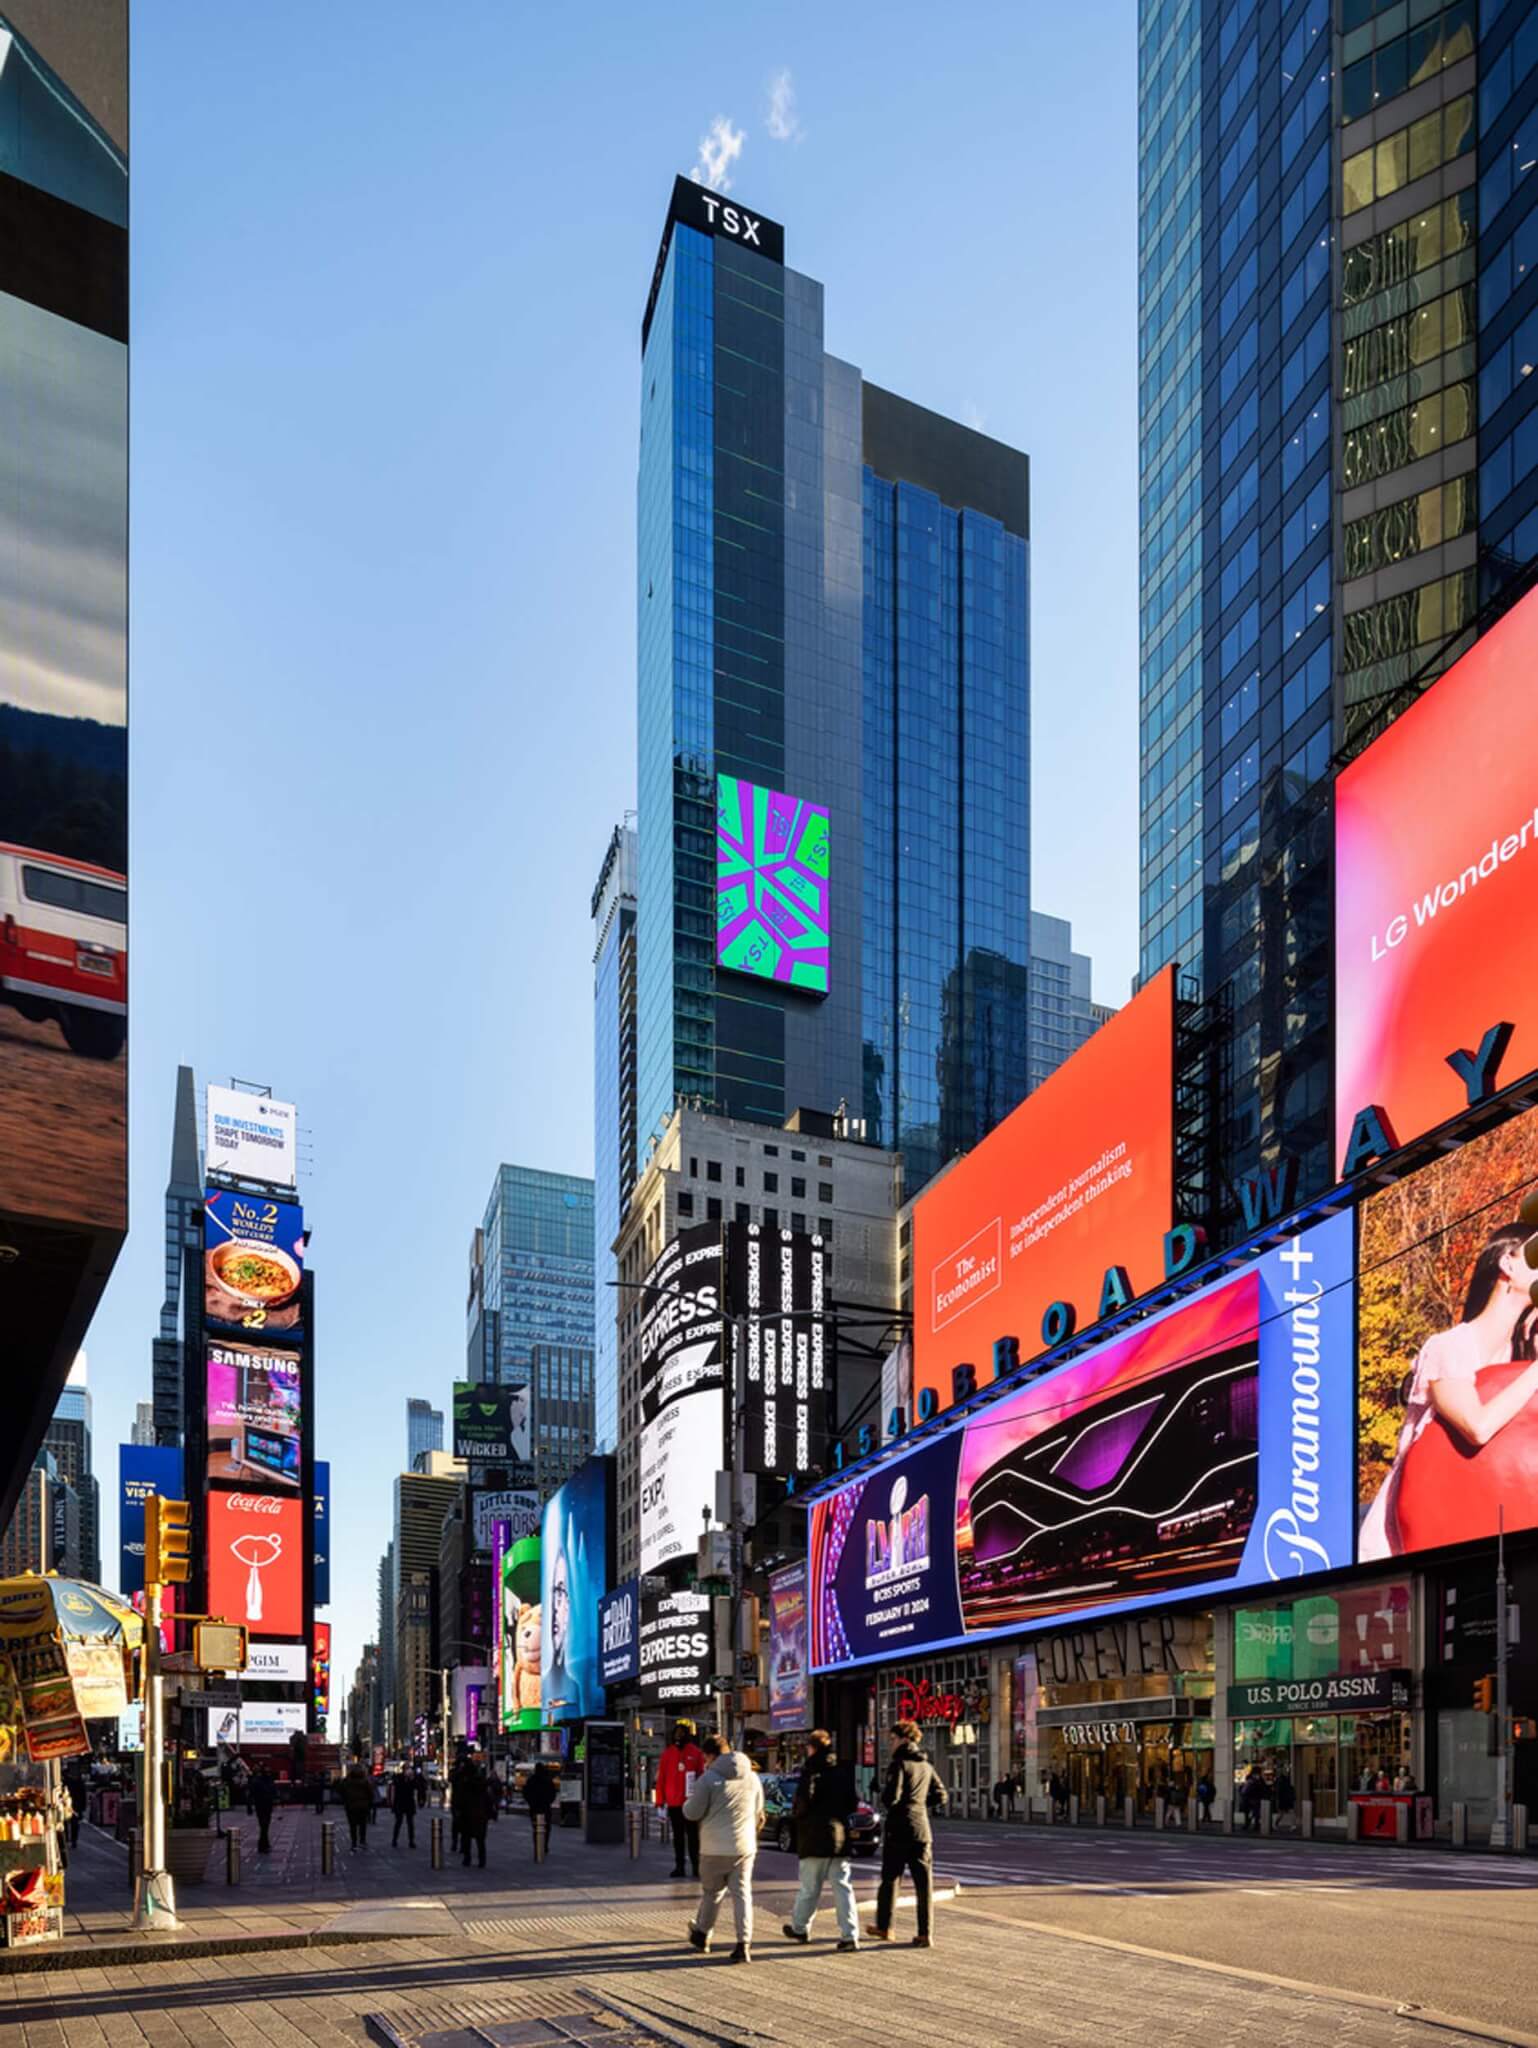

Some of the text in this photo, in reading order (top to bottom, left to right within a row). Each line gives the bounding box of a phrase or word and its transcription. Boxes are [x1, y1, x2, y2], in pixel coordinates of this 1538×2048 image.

[702, 195, 760, 246] TSX
[1371, 915, 1408, 962] LG
[214, 1125, 285, 1150] SHAPE TOMORROW
[214, 1135, 239, 1150] TODAY
[1068, 1140, 1127, 1201] journalism
[1009, 1158, 1133, 1259] for independent thinking
[747, 1240, 760, 1309] EXPRESS
[781, 1246, 793, 1314] EXPRESS
[811, 1251, 823, 1318] EXPRESS
[936, 1255, 997, 1313] The Economist
[641, 1285, 718, 1364] EXPRESS
[212, 1349, 298, 1375] SAMSUNG
[781, 1318, 793, 1386] EXPRESS
[811, 1323, 824, 1390] EXPRESS
[764, 1328, 777, 1468] EXPRESS EXPRESS
[796, 1332, 809, 1471] EXPRESS EXPRESS
[1264, 1236, 1332, 1581] Paramount+
[125, 1487, 156, 1498] VISA
[480, 1493, 512, 1511] LITTLE
[658, 1613, 699, 1630] EXPRESS
[866, 1605, 902, 1627] FEBRUARY
[641, 1632, 709, 1667] EXPRESS
[658, 1666, 699, 1681] EXPRESS
[1033, 1615, 1180, 1688] FOREVER
[658, 1684, 701, 1699] EXPRESS
[1247, 1687, 1274, 1705] U.S.
[1276, 1682, 1323, 1703] POLO
[1326, 1677, 1381, 1700] ASSN.
[1287, 1702, 1310, 1712] SINCE
[1062, 1723, 1120, 1746] FOREVER
